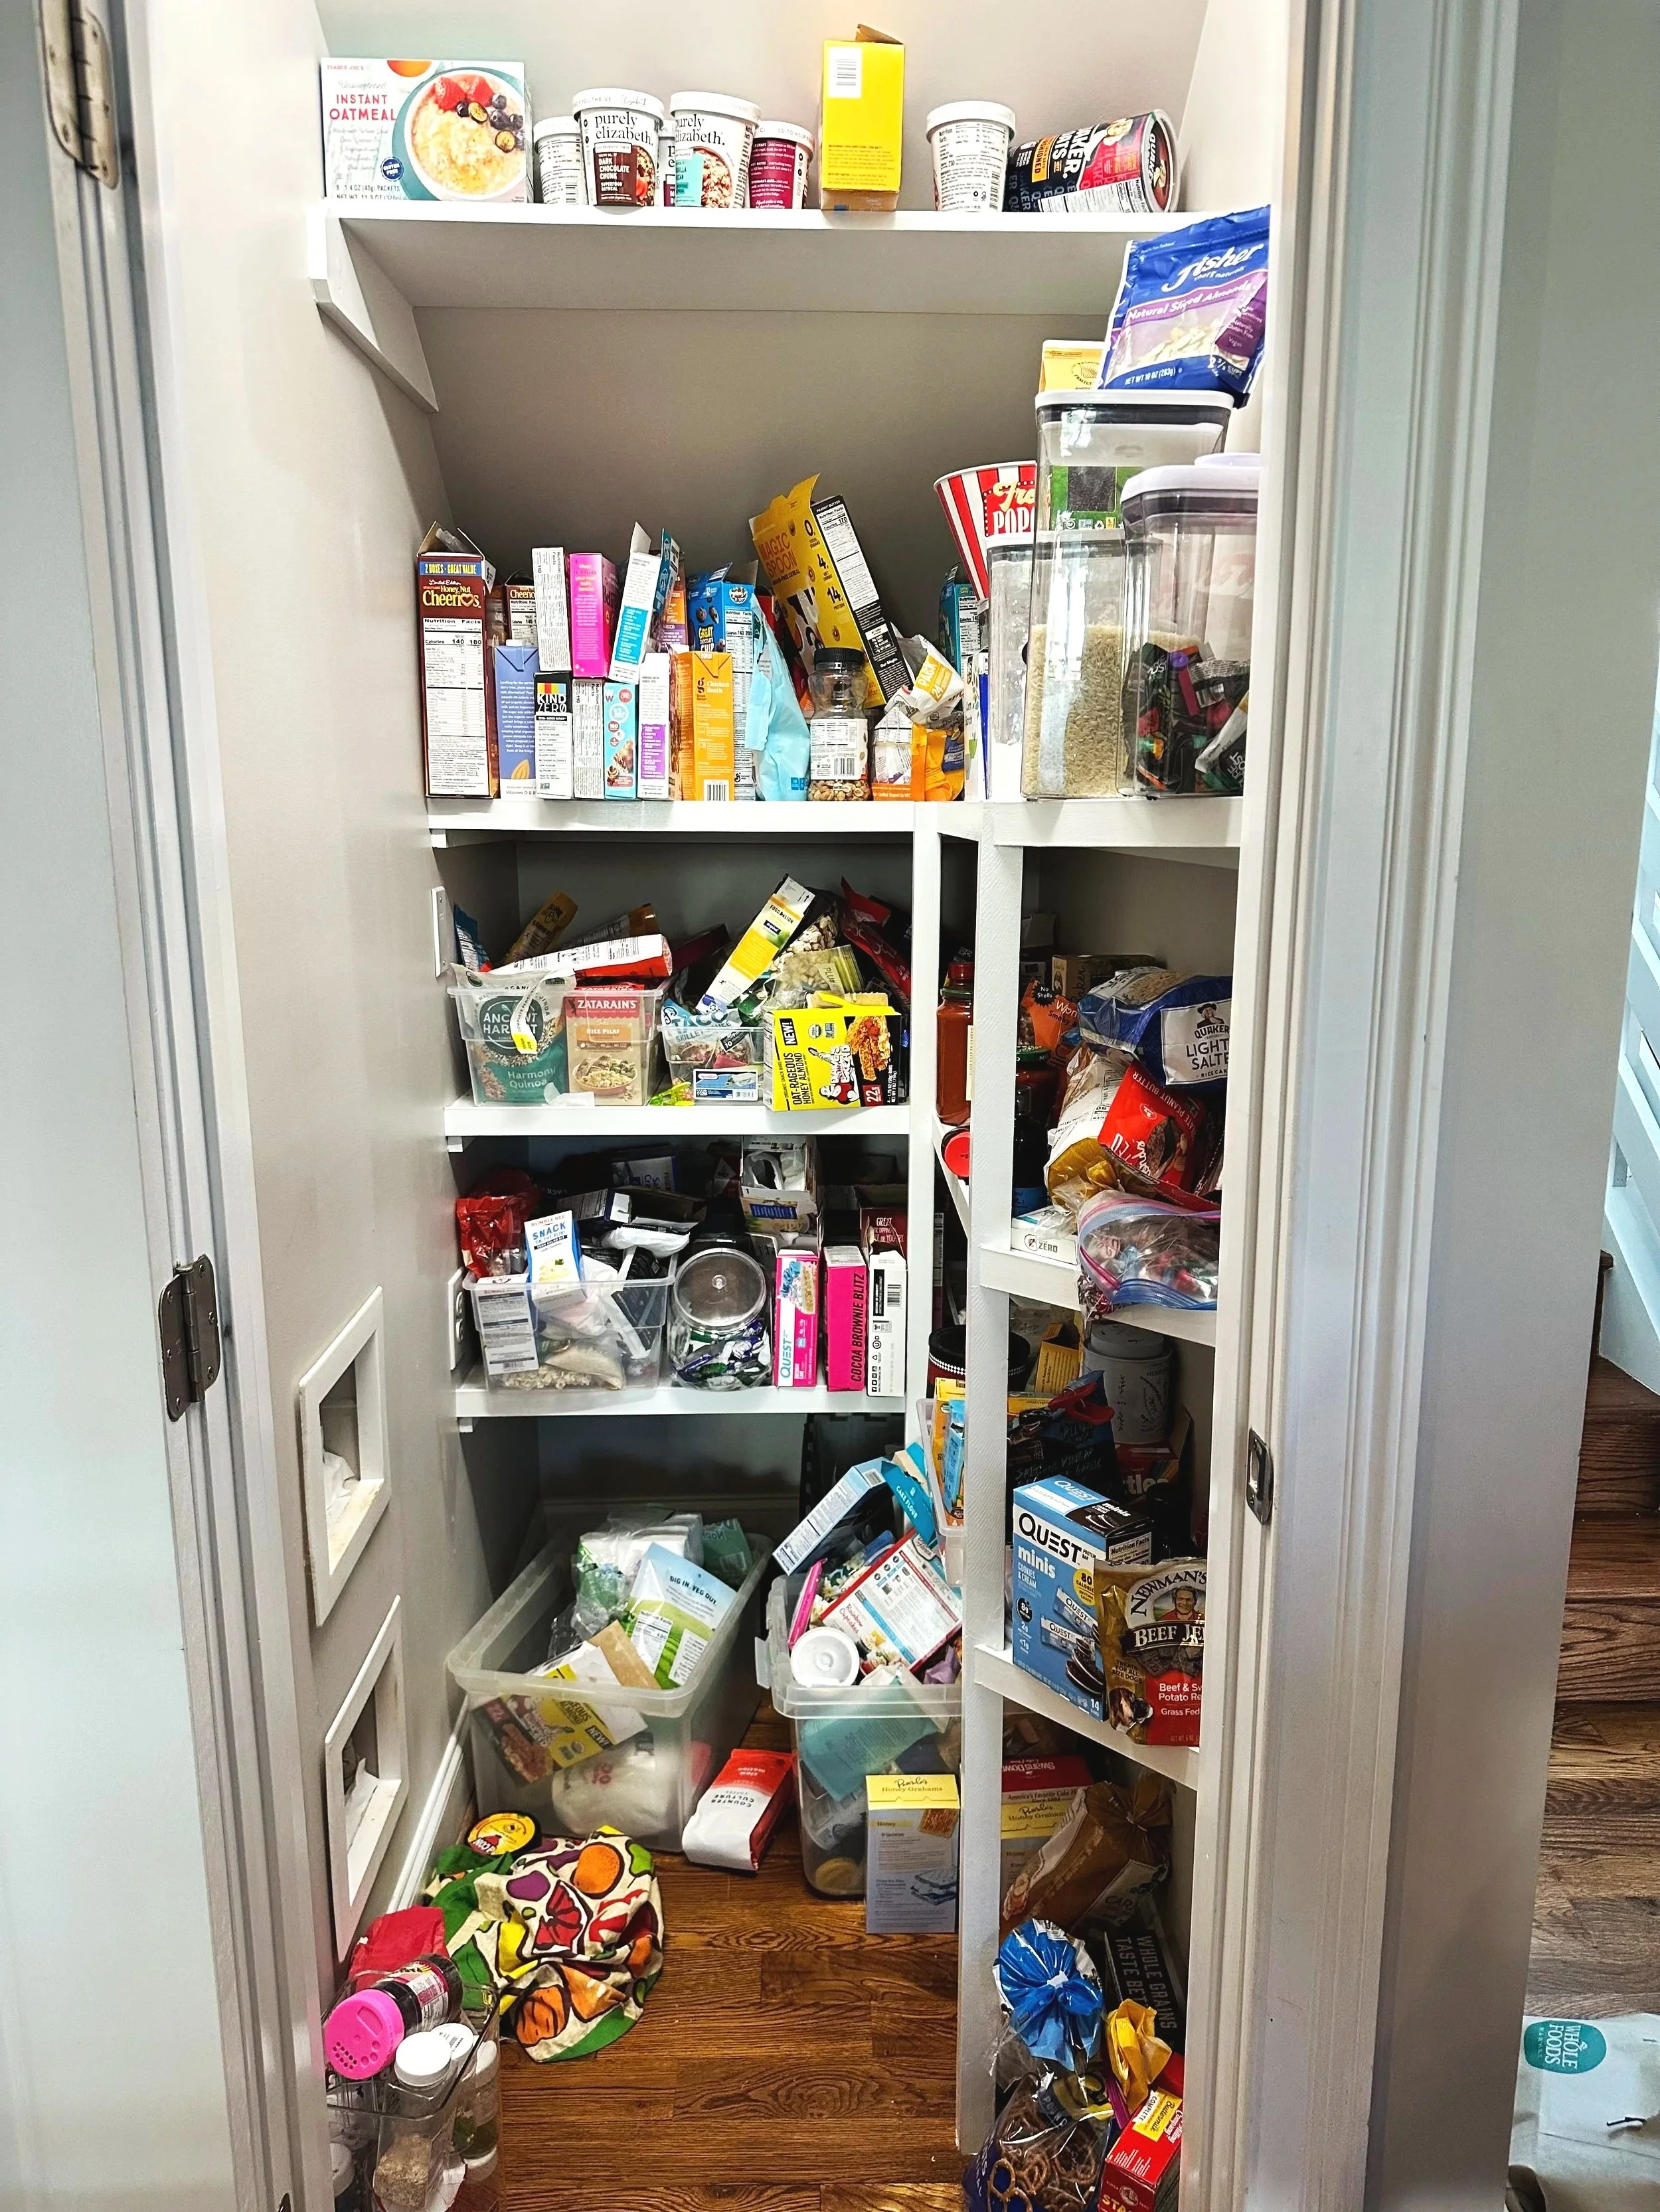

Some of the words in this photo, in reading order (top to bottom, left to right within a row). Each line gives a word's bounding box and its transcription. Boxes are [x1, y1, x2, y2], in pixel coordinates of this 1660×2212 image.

[337, 94, 388, 104] INSTANT
[329, 108, 396, 121] OATMEAL
[595, 112, 638, 128] purely
[1161, 244, 1264, 292] Fisher
[1128, 302, 1169, 320] Natural
[1203, 280, 1252, 303] Almonds
[1229, 337, 1242, 348] Vegan
[1125, 376, 1135, 386] NET
[1135, 375, 1144, 384] WT
[758, 532, 791, 562] MAGIC
[425, 564, 428, 573] 2
[429, 563, 444, 574] BOXES
[447, 564, 462, 574] GREAT
[462, 564, 477, 575] VALUE
[765, 551, 797, 578] SPOON
[440, 586, 459, 595] Honey
[698, 627, 714, 639] GREAT
[918, 662, 938, 688] PACK
[537, 694, 566, 704] KIND
[577, 999, 638, 1010] ZATARAIN'S
[782, 1022, 796, 1044] NEW!
[1194, 1025, 1230, 1039] QUAKER
[1186, 1039, 1229, 1058] LIGHT
[507, 1067, 556, 1080] Harmony
[793, 1053, 807, 1080] ALMOND
[509, 1078, 548, 1089] Quinoa
[784, 1053, 803, 1105] OAT-RAGEOUS
[800, 1080, 811, 1104] HONEY
[1132, 1071, 1159, 1095] BUTTER
[1159, 1095, 1185, 1119] PEANUT
[531, 1218, 554, 1227] BUMBLE
[532, 1222, 566, 1240] SNACK
[876, 1217, 892, 1227] GREAT
[1038, 1241, 1058, 1253] ZERO
[853, 1273, 865, 1301] BLITZ
[851, 1303, 864, 1348] BROWNIE
[780, 1340, 792, 1379] QUEST
[851, 1350, 863, 1382] COCOA
[1054, 1480, 1100, 1502] QUEST
[896, 1486, 909, 1503] CAKE
[904, 1499, 918, 1520] FLOUR
[1102, 1502, 1131, 1517] minis
[1019, 1512, 1082, 1563] QUEST
[1111, 1542, 1135, 1555] Nutrition
[1135, 1537, 1149, 1547] Facts
[1018, 1545, 1056, 1579] minis
[1018, 1562, 1036, 1579] COOKIES
[1021, 1575, 1037, 1589] CREAM
[1080, 1572, 1092, 1585] 80
[669, 1575, 681, 1585] DIG
[692, 1585, 704, 1596] VEG
[705, 1593, 717, 1605] OUT.
[845, 1604, 863, 1627] Rainbow
[1021, 1602, 1029, 1613] 8g
[1066, 1597, 1088, 1620] QUEST
[839, 1608, 859, 1634] Cupcakes
[1021, 1621, 1029, 1632] 2g
[1049, 1622, 1070, 1638] QUEST
[1134, 1625, 1177, 1648] BEEF
[1111, 1669, 1124, 1678] SIZE
[1124, 1672, 1143, 1684] DOGS
[1115, 1665, 1127, 1674] FOR
[1128, 1668, 1139, 1677] ALL
[1159, 1683, 1181, 1692] Beef
[1182, 1684, 1189, 1692] &
[1090, 1698, 1100, 1711] 14
[1159, 1693, 1189, 1702] Potato
[1161, 1708, 1183, 1717] Grass
[1185, 1707, 1200, 1716] Fed
[587, 1728, 609, 1747] NEW!
[714, 1794, 754, 1803] CULTURE
[1116, 1937, 1140, 1976] TASTE
[1136, 1935, 1163, 1979] WHOLE
[1125, 1980, 1149, 2007] BET
[1149, 1983, 1177, 2029] GRAINS
[1544, 2023, 1564, 2065] FOODS
[1562, 2025, 1582, 2070] WHOLE
[1138, 2096, 1157, 2121] COMPLETE
[1150, 2100, 1175, 2132] Buttermilk
